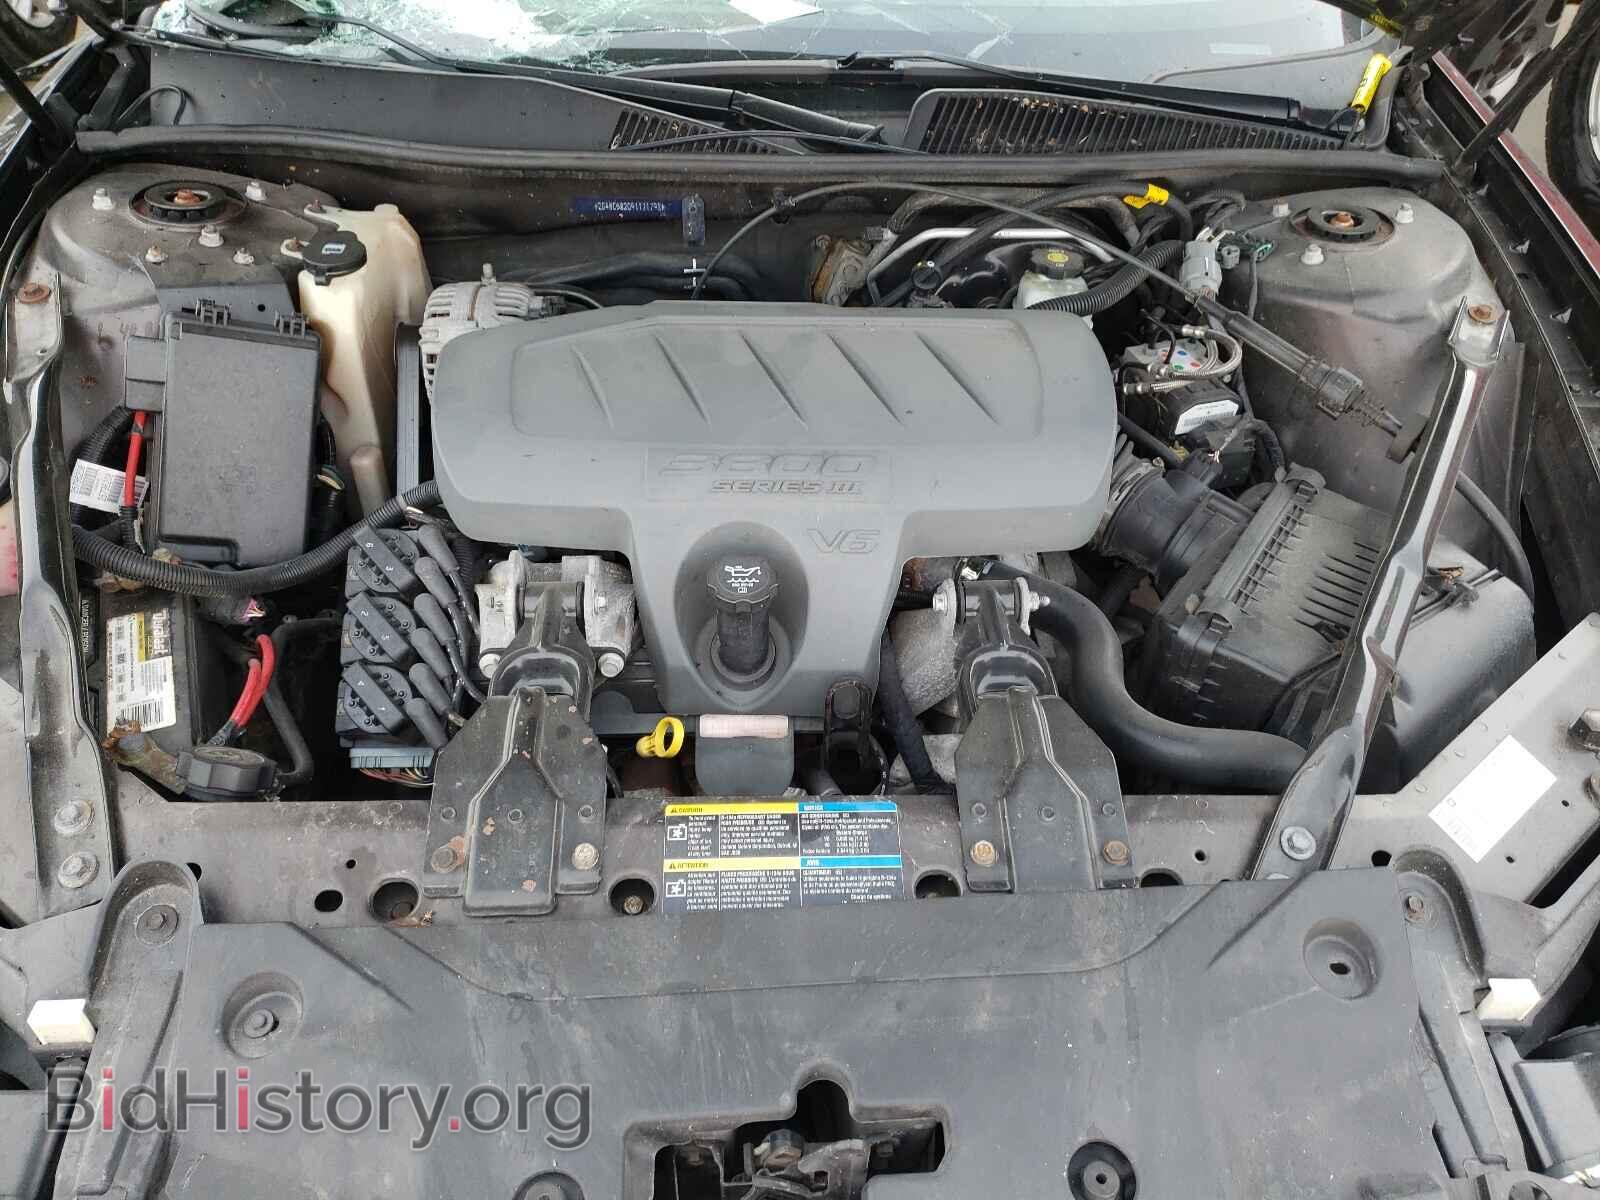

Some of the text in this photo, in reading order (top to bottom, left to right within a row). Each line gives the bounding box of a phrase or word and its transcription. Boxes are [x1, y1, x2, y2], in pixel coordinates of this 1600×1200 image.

[659, 452, 876, 476] 3800
[711, 479, 824, 495] SERIES
[807, 528, 881, 554] V6
